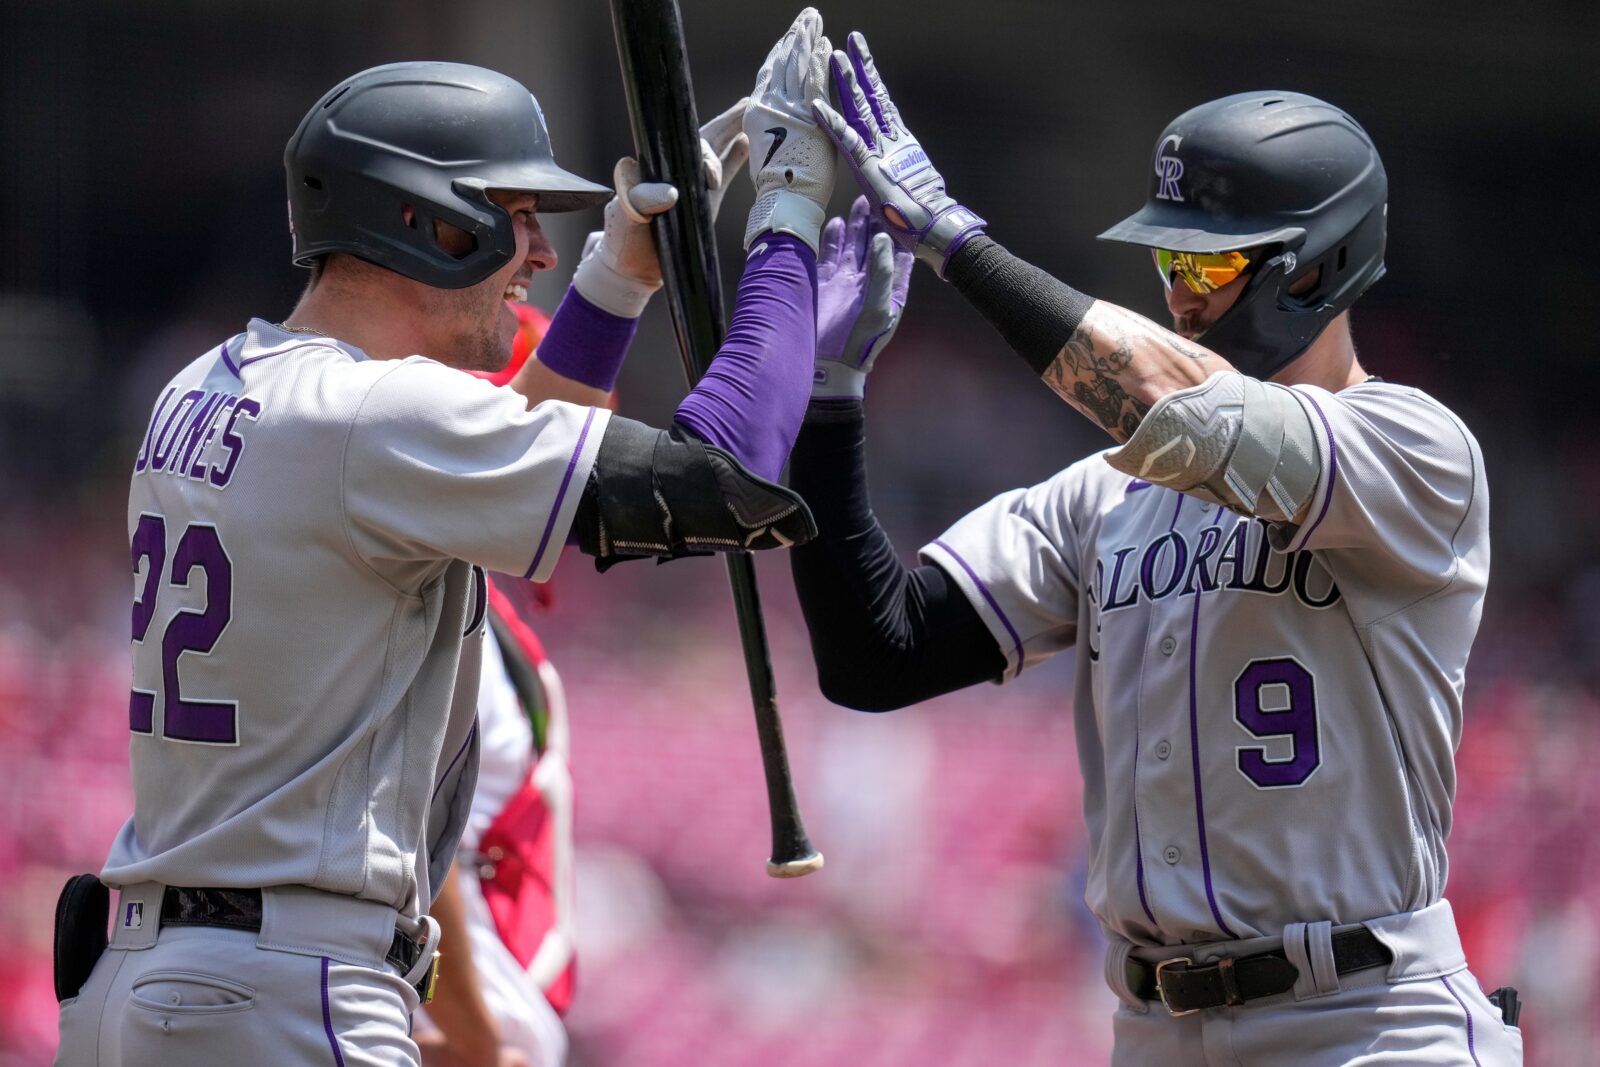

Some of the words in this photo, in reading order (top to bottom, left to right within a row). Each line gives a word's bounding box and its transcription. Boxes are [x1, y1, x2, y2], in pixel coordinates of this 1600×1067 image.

[889, 149, 927, 178] Franklin
[135, 384, 263, 491] JONES
[129, 510, 241, 746] 22
[1232, 655, 1323, 790] 9
